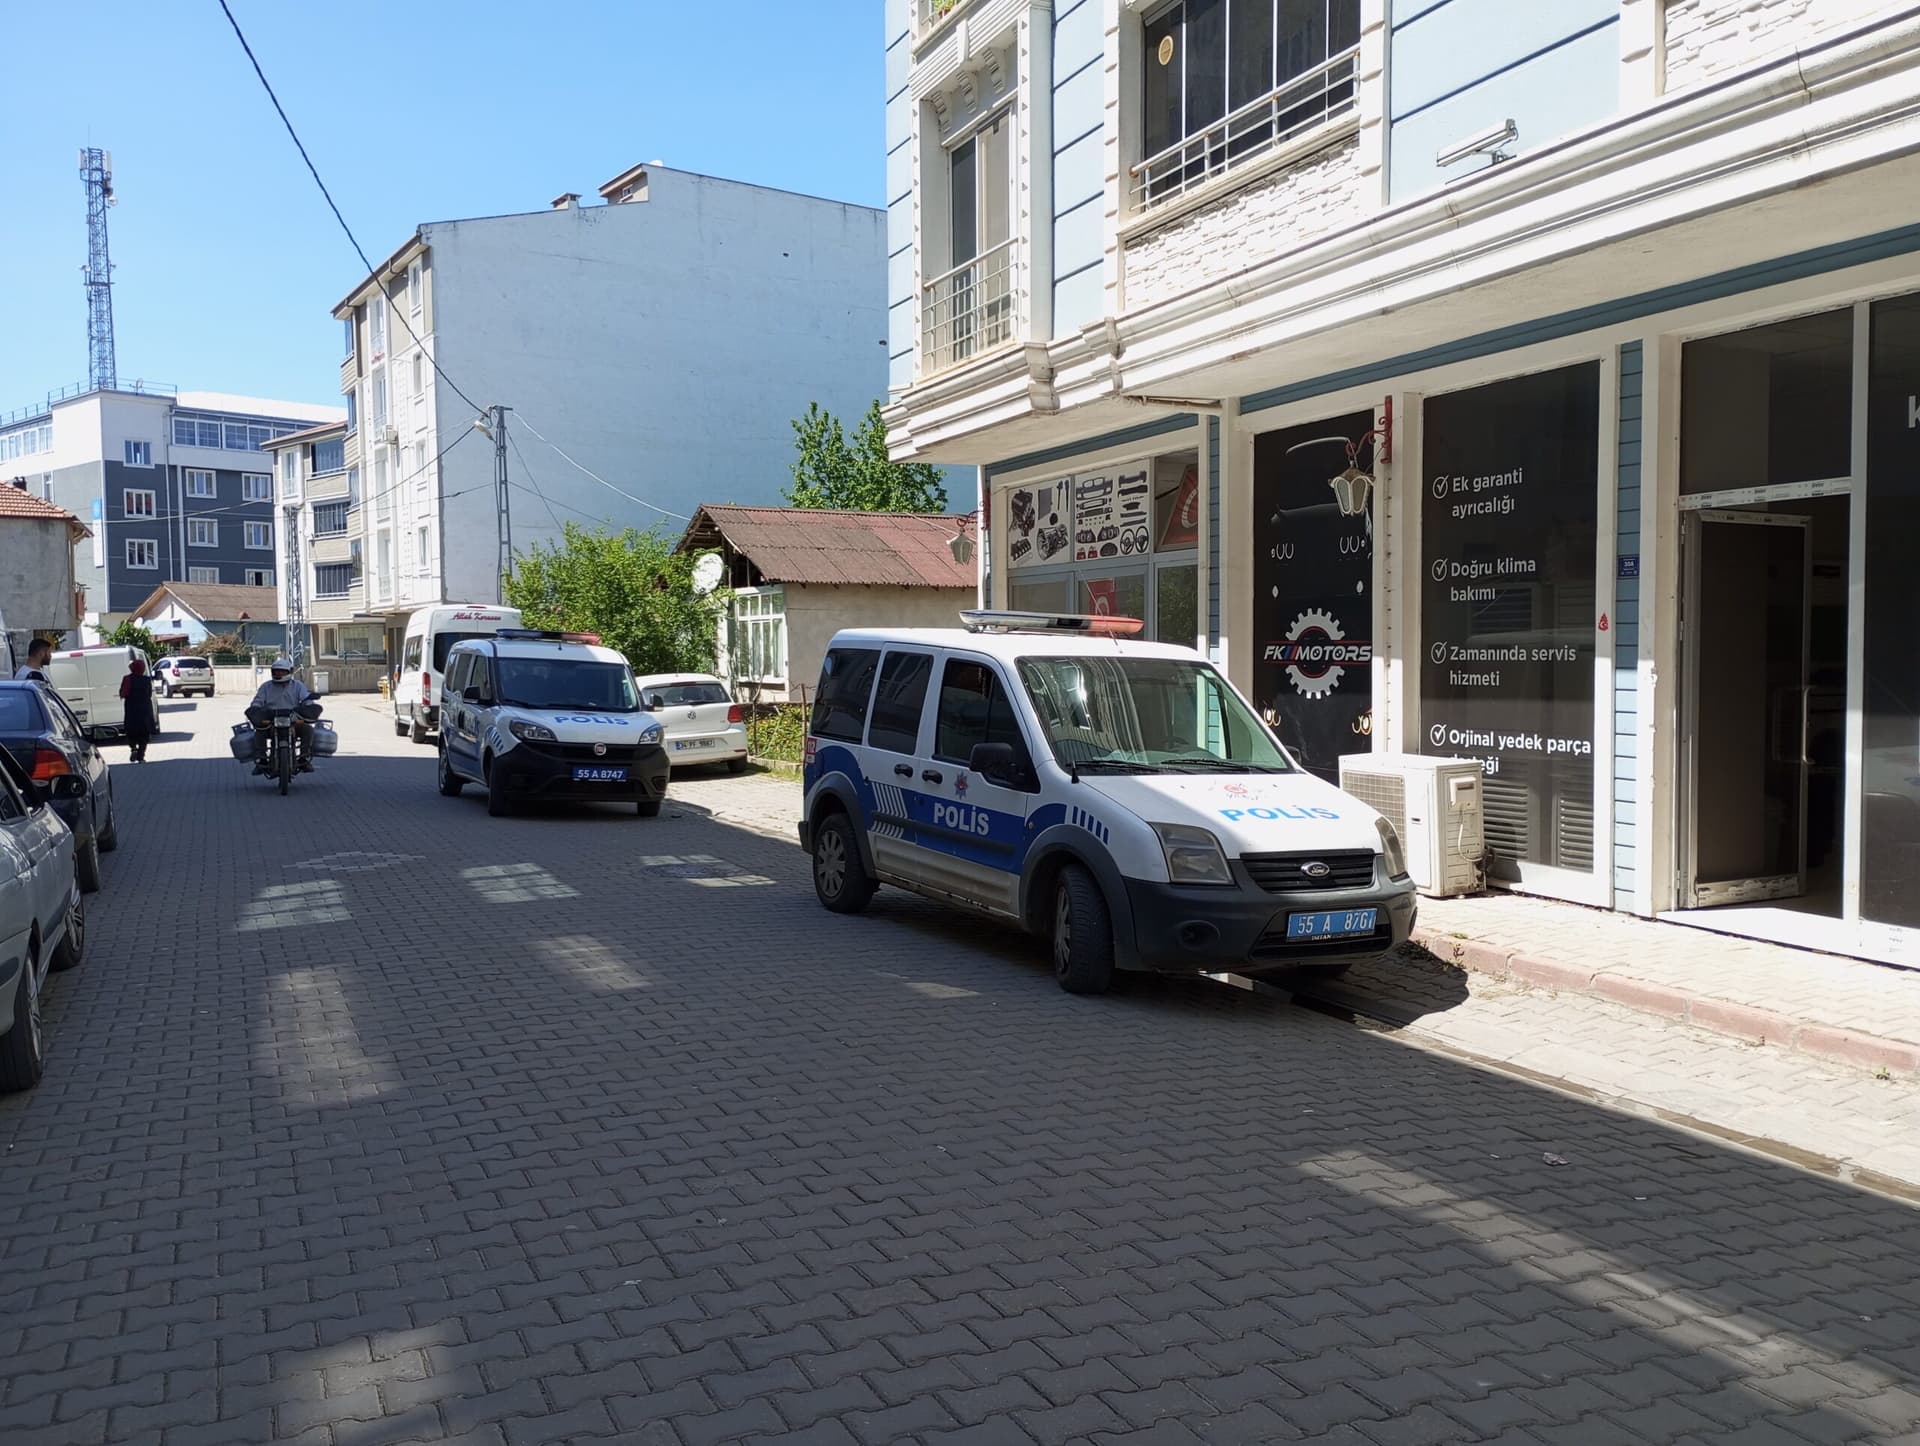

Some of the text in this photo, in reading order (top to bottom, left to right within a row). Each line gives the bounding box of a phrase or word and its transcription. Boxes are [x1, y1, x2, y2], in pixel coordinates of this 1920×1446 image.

[1453, 468, 1523, 492] Ek garanti
[1452, 495, 1515, 519] ayrıcalığı
[1451, 557, 1536, 578] Doğru klima
[1450, 585, 1496, 601] bakımı
[1450, 645, 1577, 661] Zamanında servis
[1450, 670, 1500, 686] hizmeti
[1449, 729, 1591, 756] Orjinal yedek parça
[578, 769, 623, 779] 55 A 8747
[933, 802, 989, 836] POLİS
[1219, 804, 1340, 821] POLİS
[1297, 916, 1315, 934] 55
[1322, 914, 1331, 932] A
